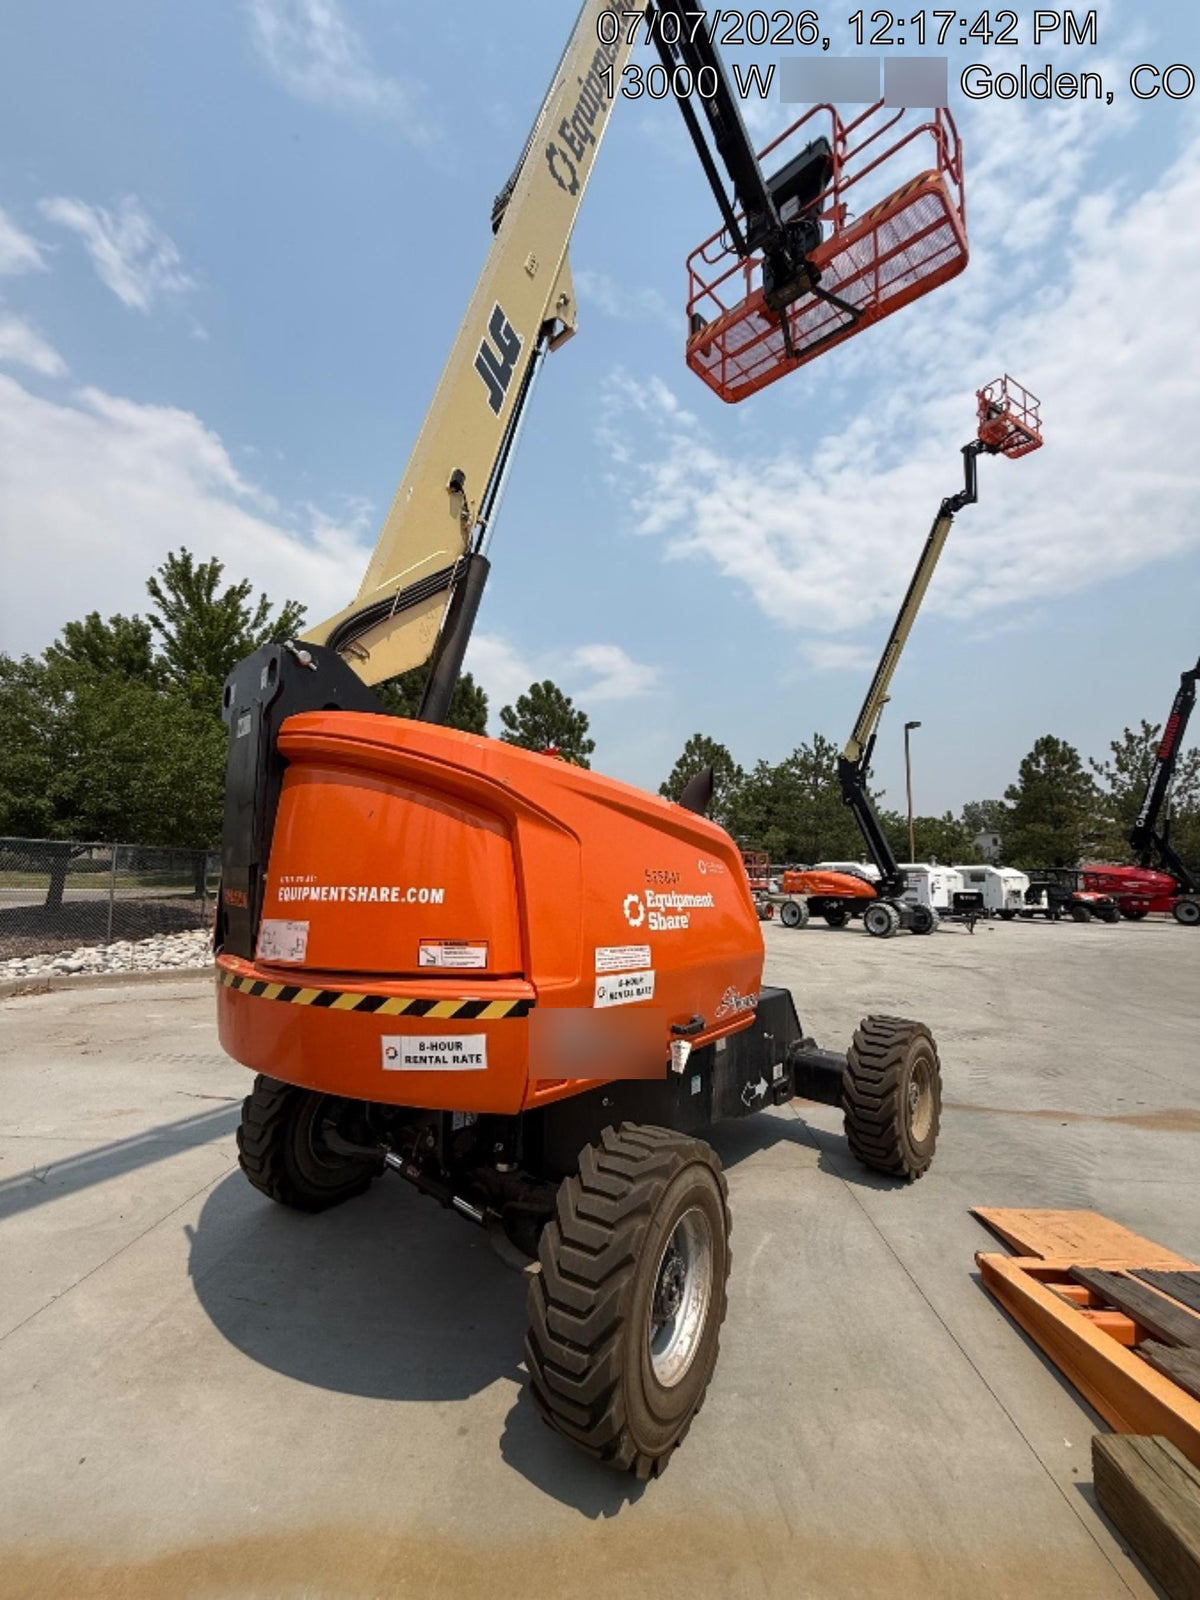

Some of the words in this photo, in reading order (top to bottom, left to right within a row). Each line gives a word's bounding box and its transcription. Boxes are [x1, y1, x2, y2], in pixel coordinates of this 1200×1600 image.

[473, 300, 523, 417] JLG
[278, 886, 445, 904] EQUIPMENTSHARE.COM
[645, 889, 715, 912] Equipment
[648, 911, 689, 930] Share
[419, 1041, 463, 1051] 8-HOUR
[404, 1055, 448, 1064] RENTAL
[452, 1053, 483, 1064] RATE
